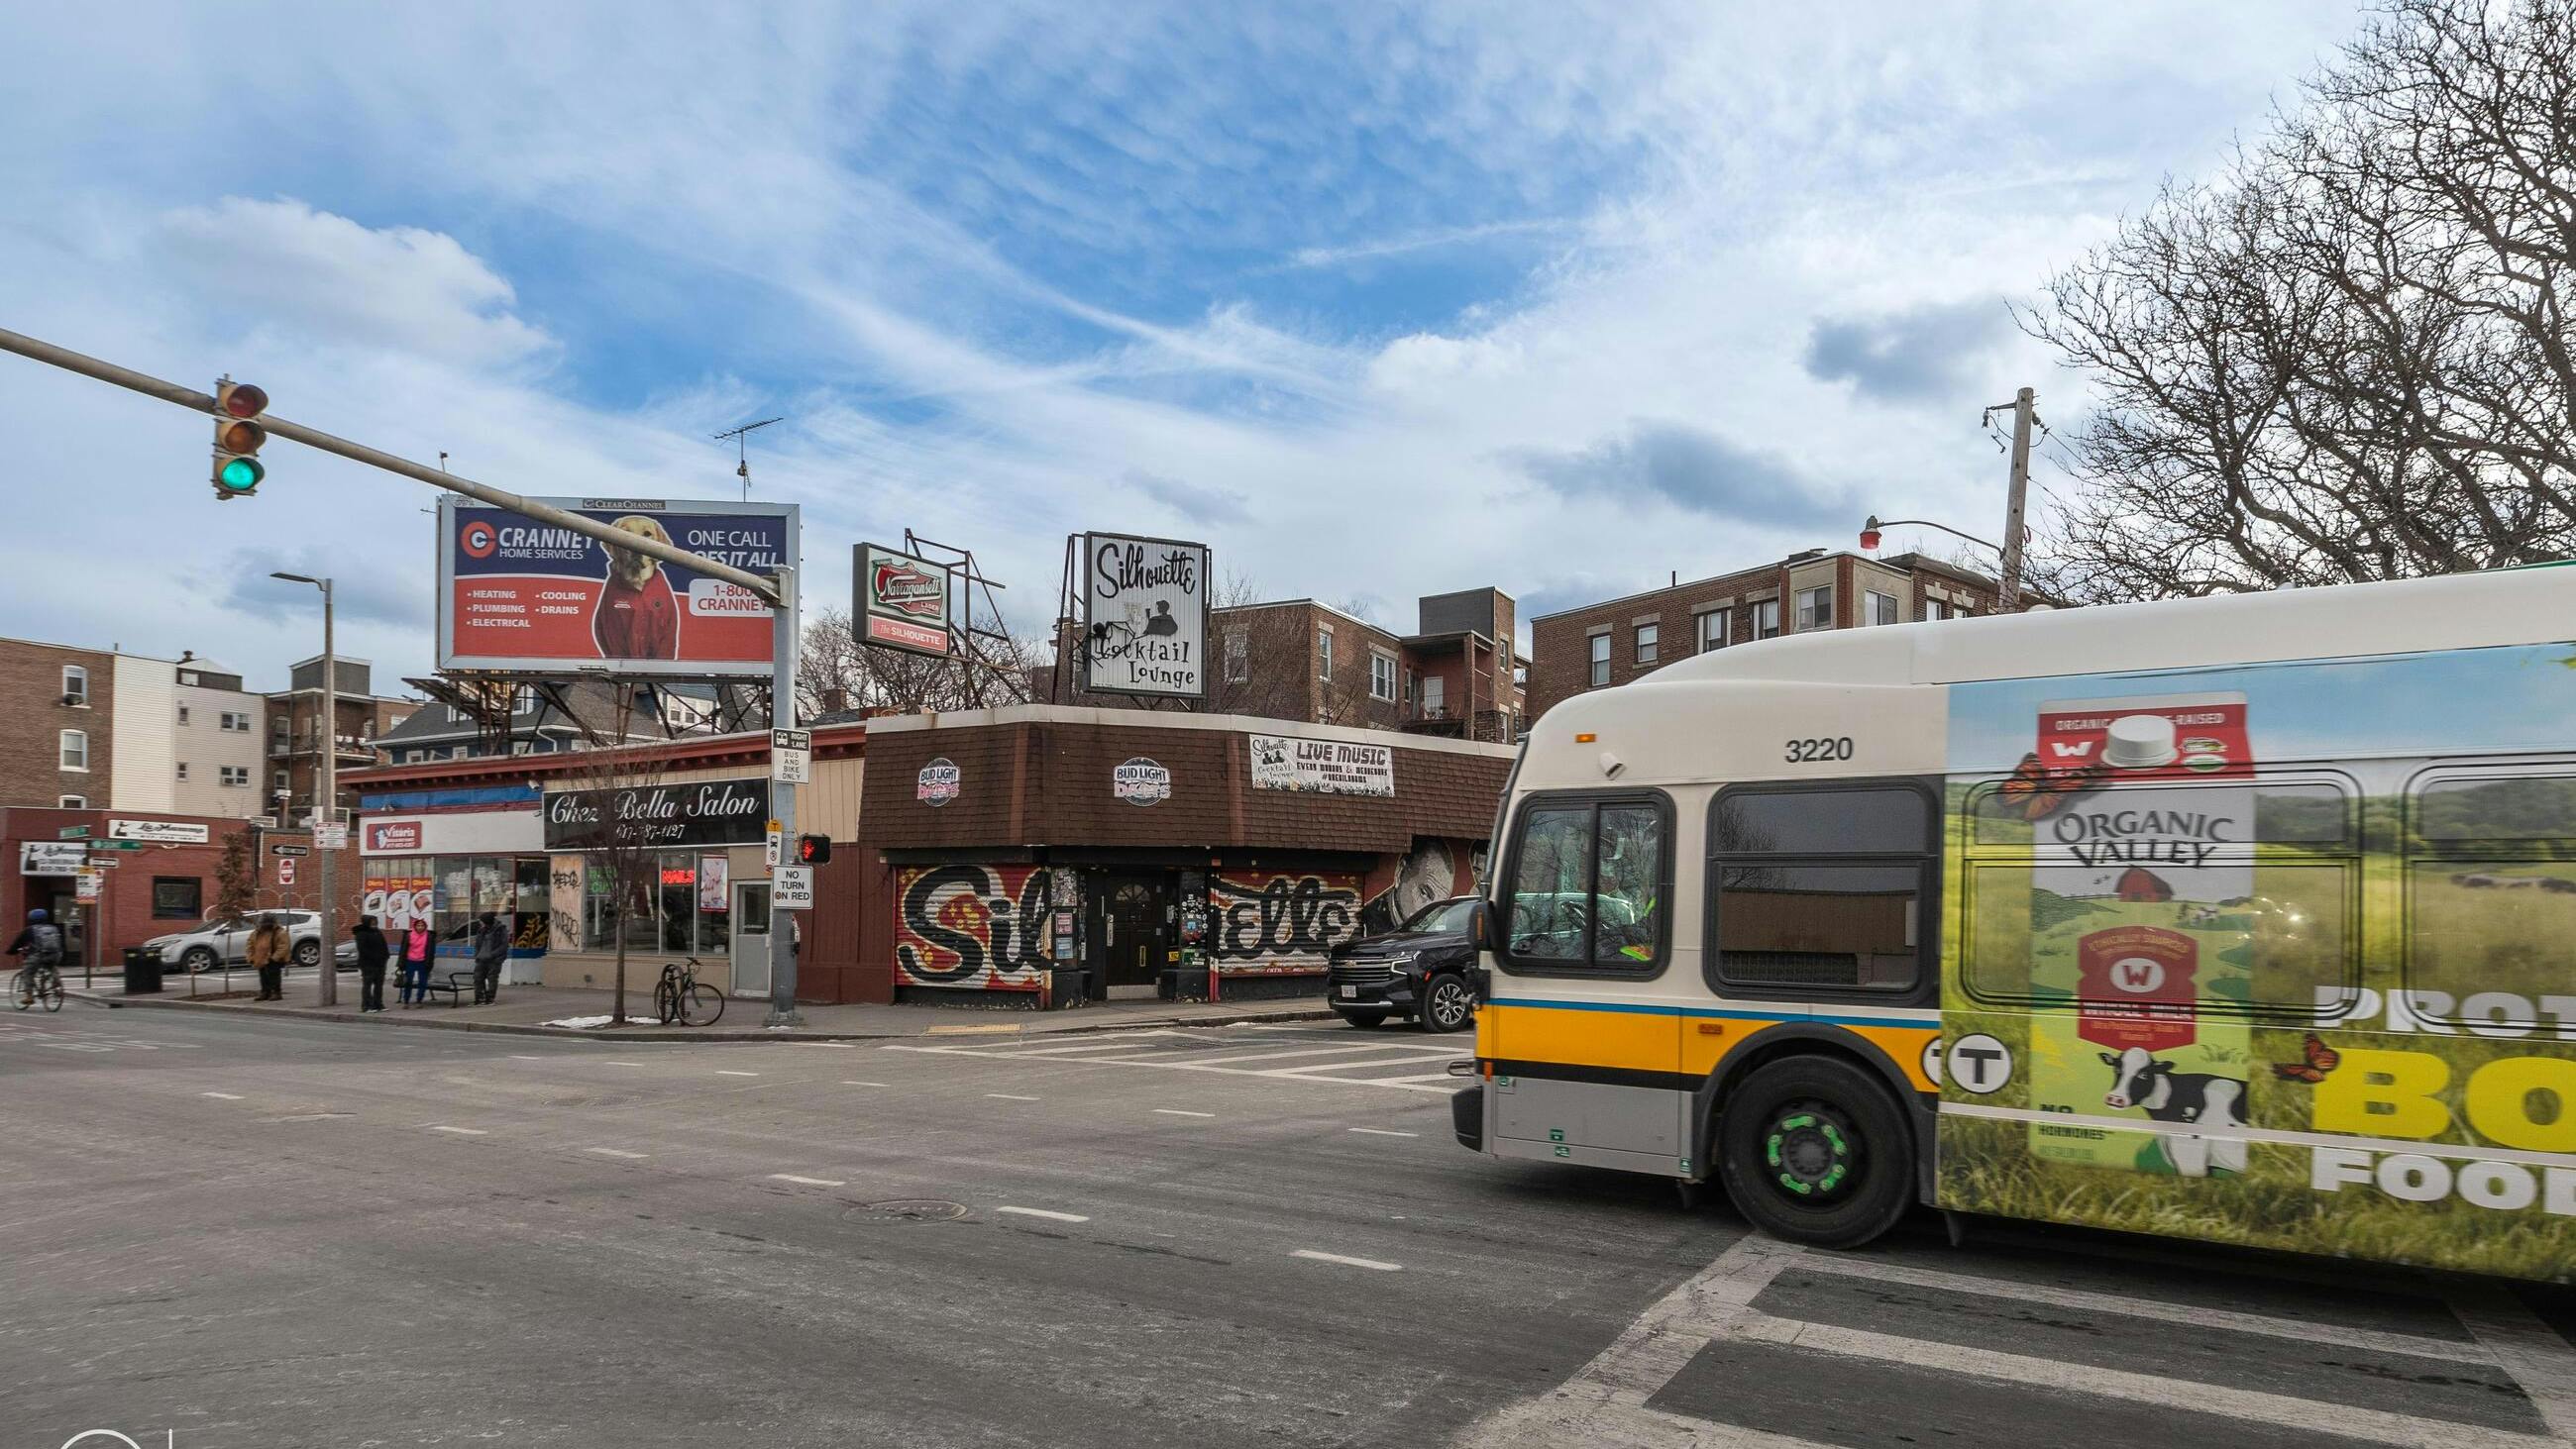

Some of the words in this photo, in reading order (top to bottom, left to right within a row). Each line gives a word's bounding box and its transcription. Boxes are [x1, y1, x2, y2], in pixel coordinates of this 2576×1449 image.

[688, 529, 726, 546] ONE
[728, 531, 772, 547] CALL
[499, 549, 533, 558] HOME
[535, 550, 584, 560] SERVICES
[729, 551, 747, 567] IT
[747, 552, 778, 567] ALL
[1097, 543, 1196, 598] Silhouette
[541, 591, 587, 600] COOLING
[891, 627, 940, 645] SILHOUETTE
[1100, 640, 1189, 665] Cocktail
[1128, 661, 1195, 688] Lounge
[1297, 742, 1333, 761] LIVE
[1337, 746, 1386, 766] MUSIC
[1785, 737, 1853, 763] 3220
[920, 770, 936, 781] BUD
[937, 769, 957, 780] LIGHT
[1117, 768, 1137, 778] BUD
[1139, 768, 1166, 780] LIGHT
[614, 789, 680, 820] Bella
[686, 785, 760, 816] Salon
[2053, 810, 2236, 843] ORGANIC
[2069, 838, 2218, 869] VALLEY
[781, 880, 805, 889] TURN
[785, 871, 800, 880] NO
[775, 891, 788, 900] ON
[2122, 965, 2151, 985] W
[1958, 1048, 2001, 1085] T
